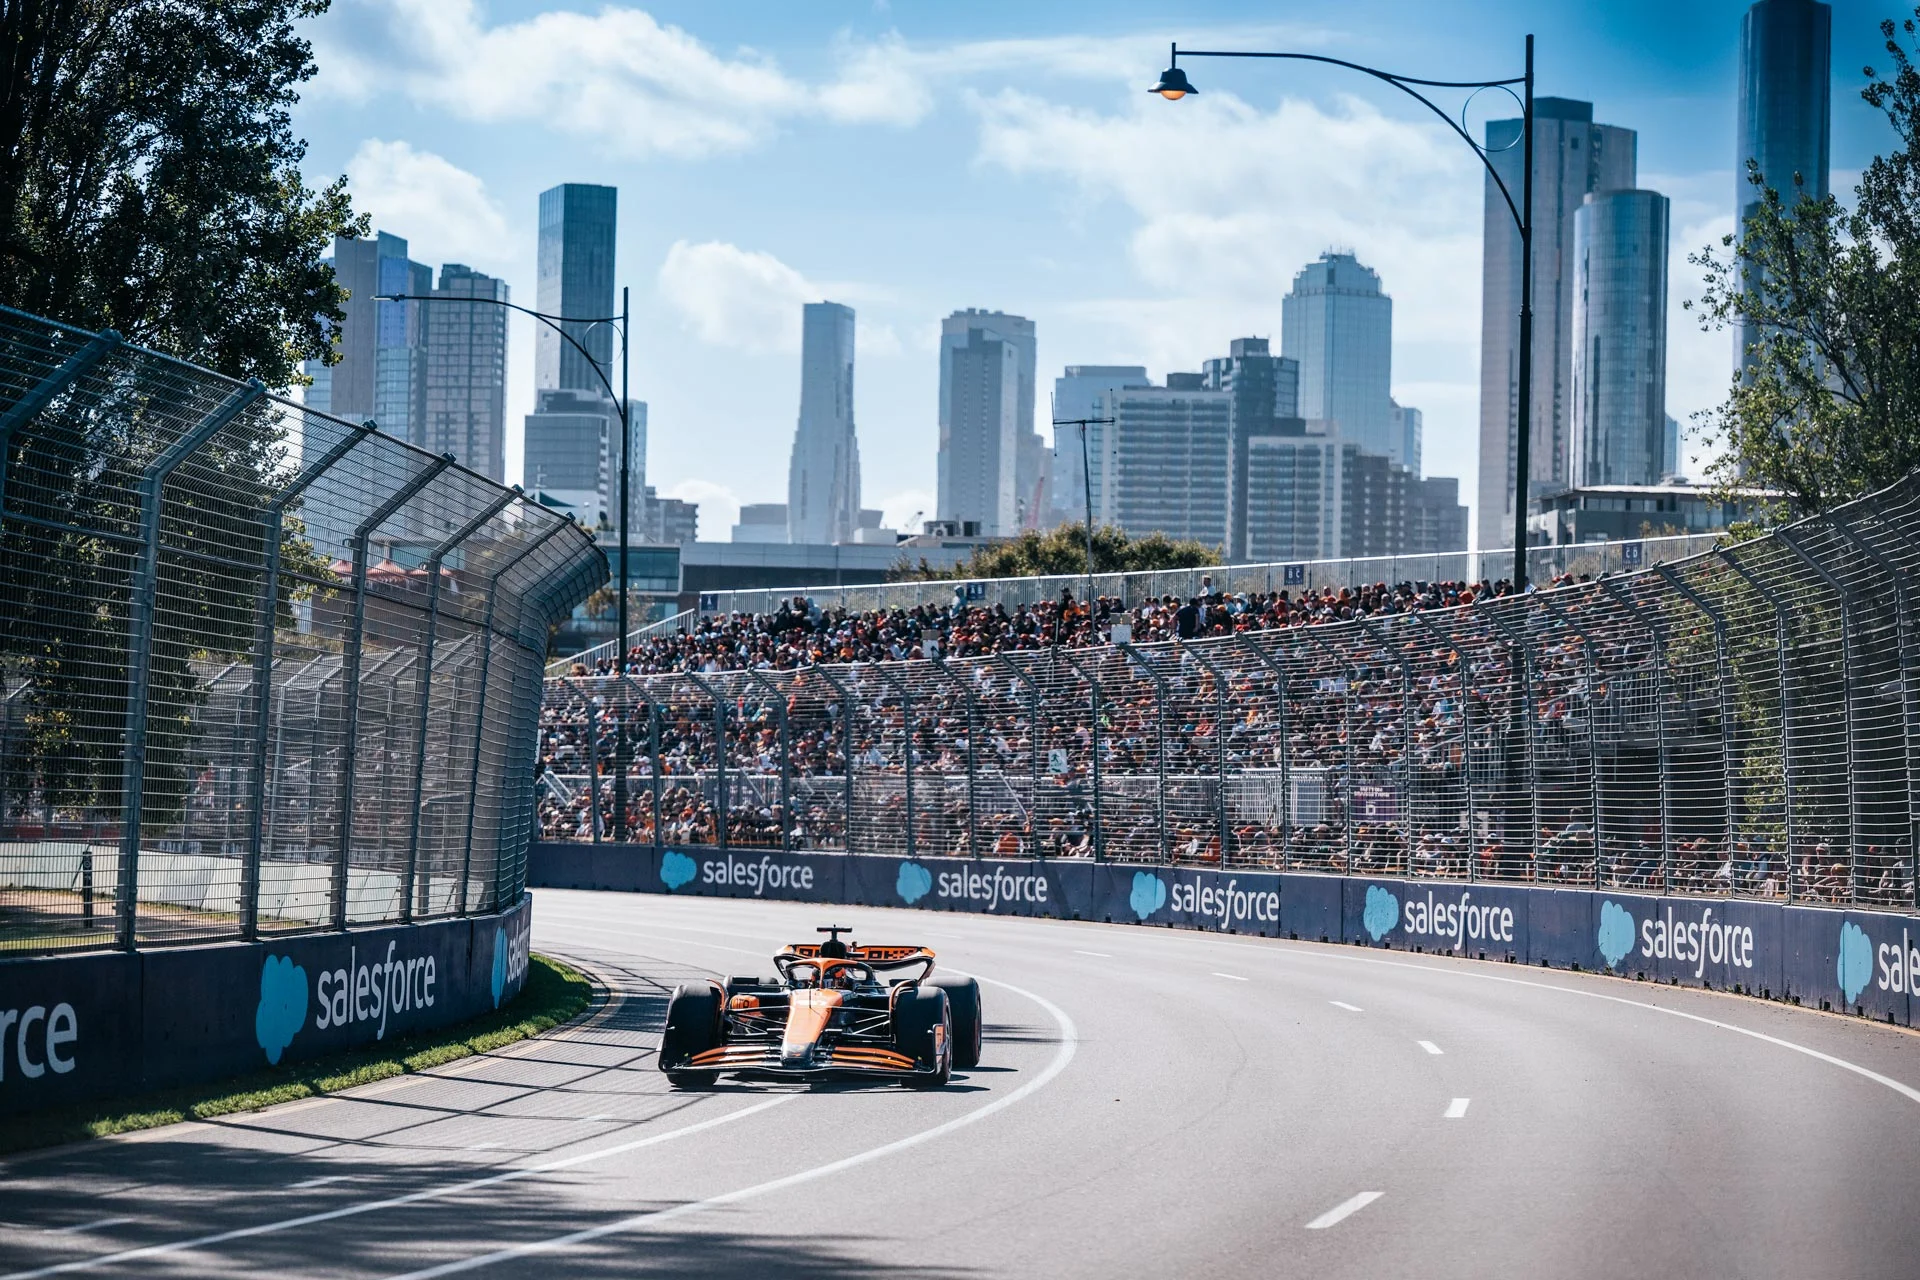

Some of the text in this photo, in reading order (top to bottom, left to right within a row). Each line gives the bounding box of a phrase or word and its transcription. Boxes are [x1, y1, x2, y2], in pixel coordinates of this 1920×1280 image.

[702, 853, 814, 895] salesforce
[937, 864, 1048, 910] salesforce
[1171, 875, 1280, 930] salesforce
[1404, 890, 1515, 951] salesforce
[1641, 906, 1754, 979] salesforce
[315, 939, 436, 1041] salesforce
